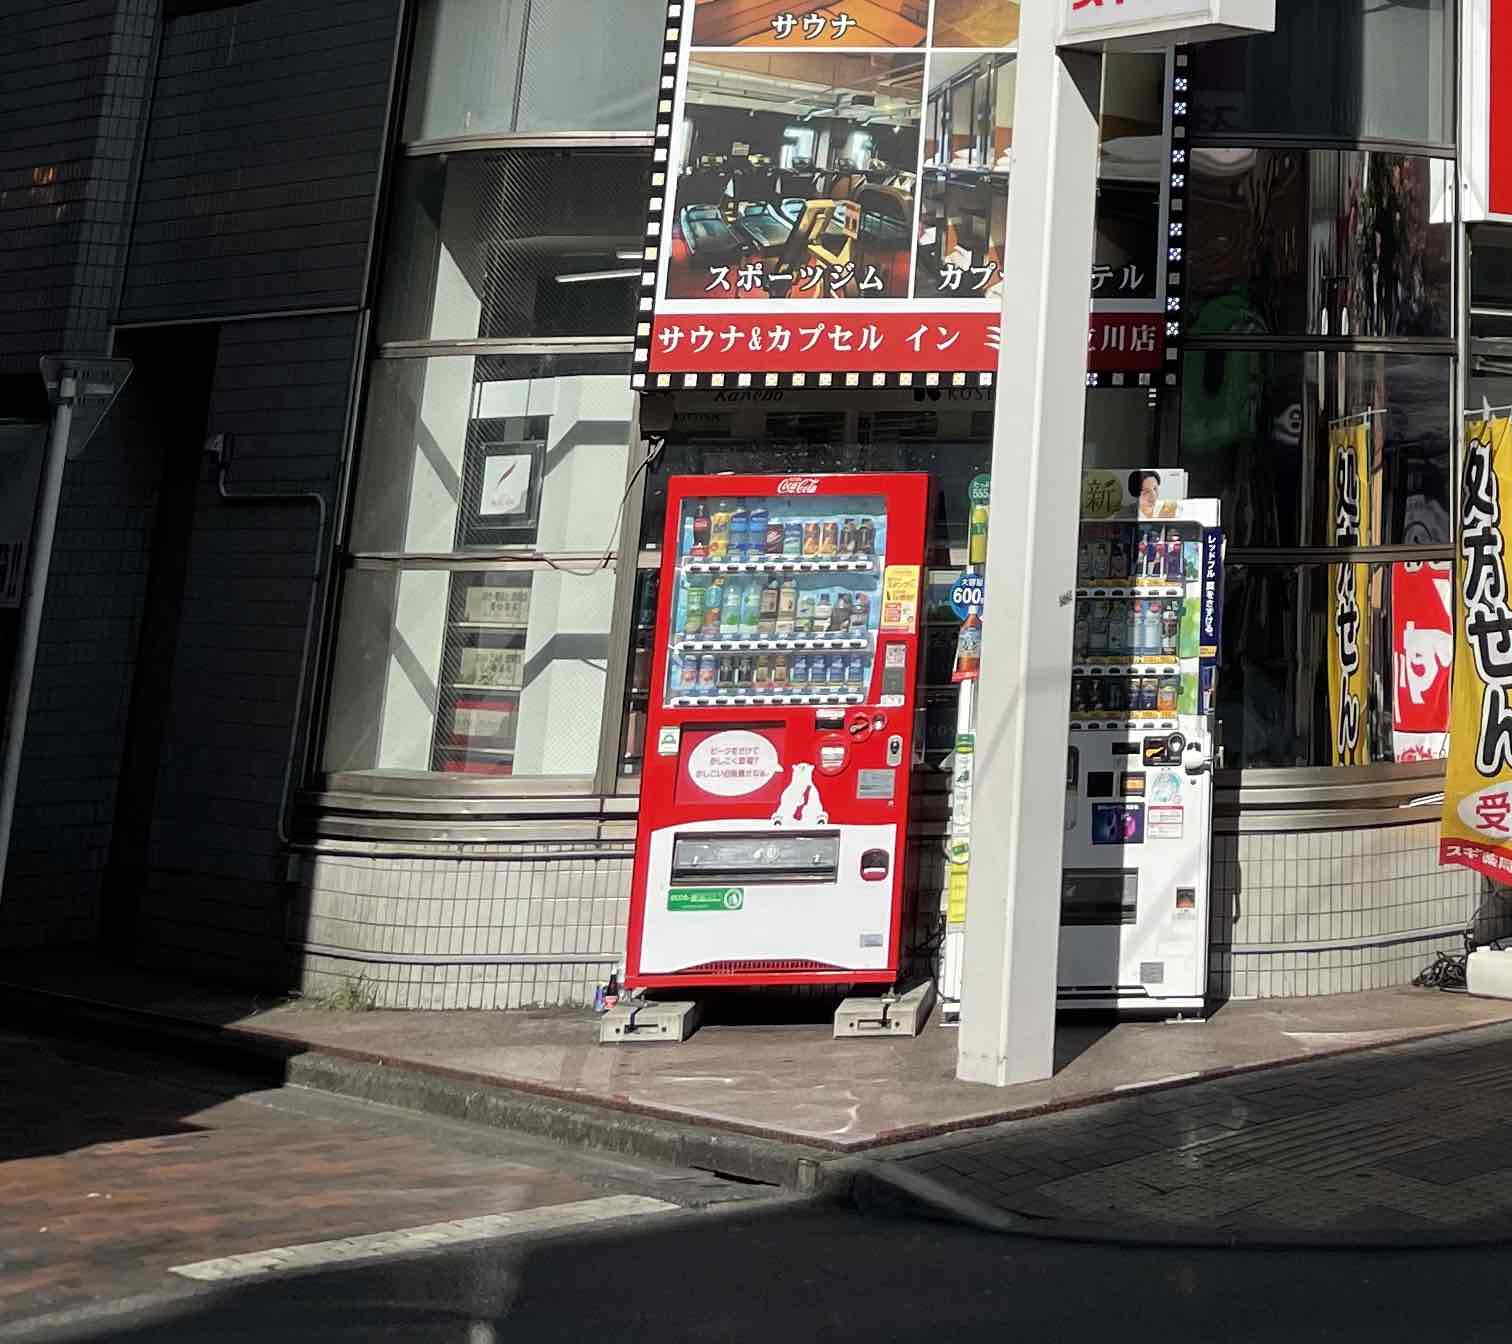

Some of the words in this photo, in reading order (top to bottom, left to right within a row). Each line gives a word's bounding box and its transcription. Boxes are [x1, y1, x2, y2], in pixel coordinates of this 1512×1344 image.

[771, 13, 857, 41] サウナ
[704, 263, 885, 293] スポーツジム
[658, 324, 884, 353] サウナ&カプセル
[905, 324, 961, 353] イン
[1086, 477, 1120, 513] 新
